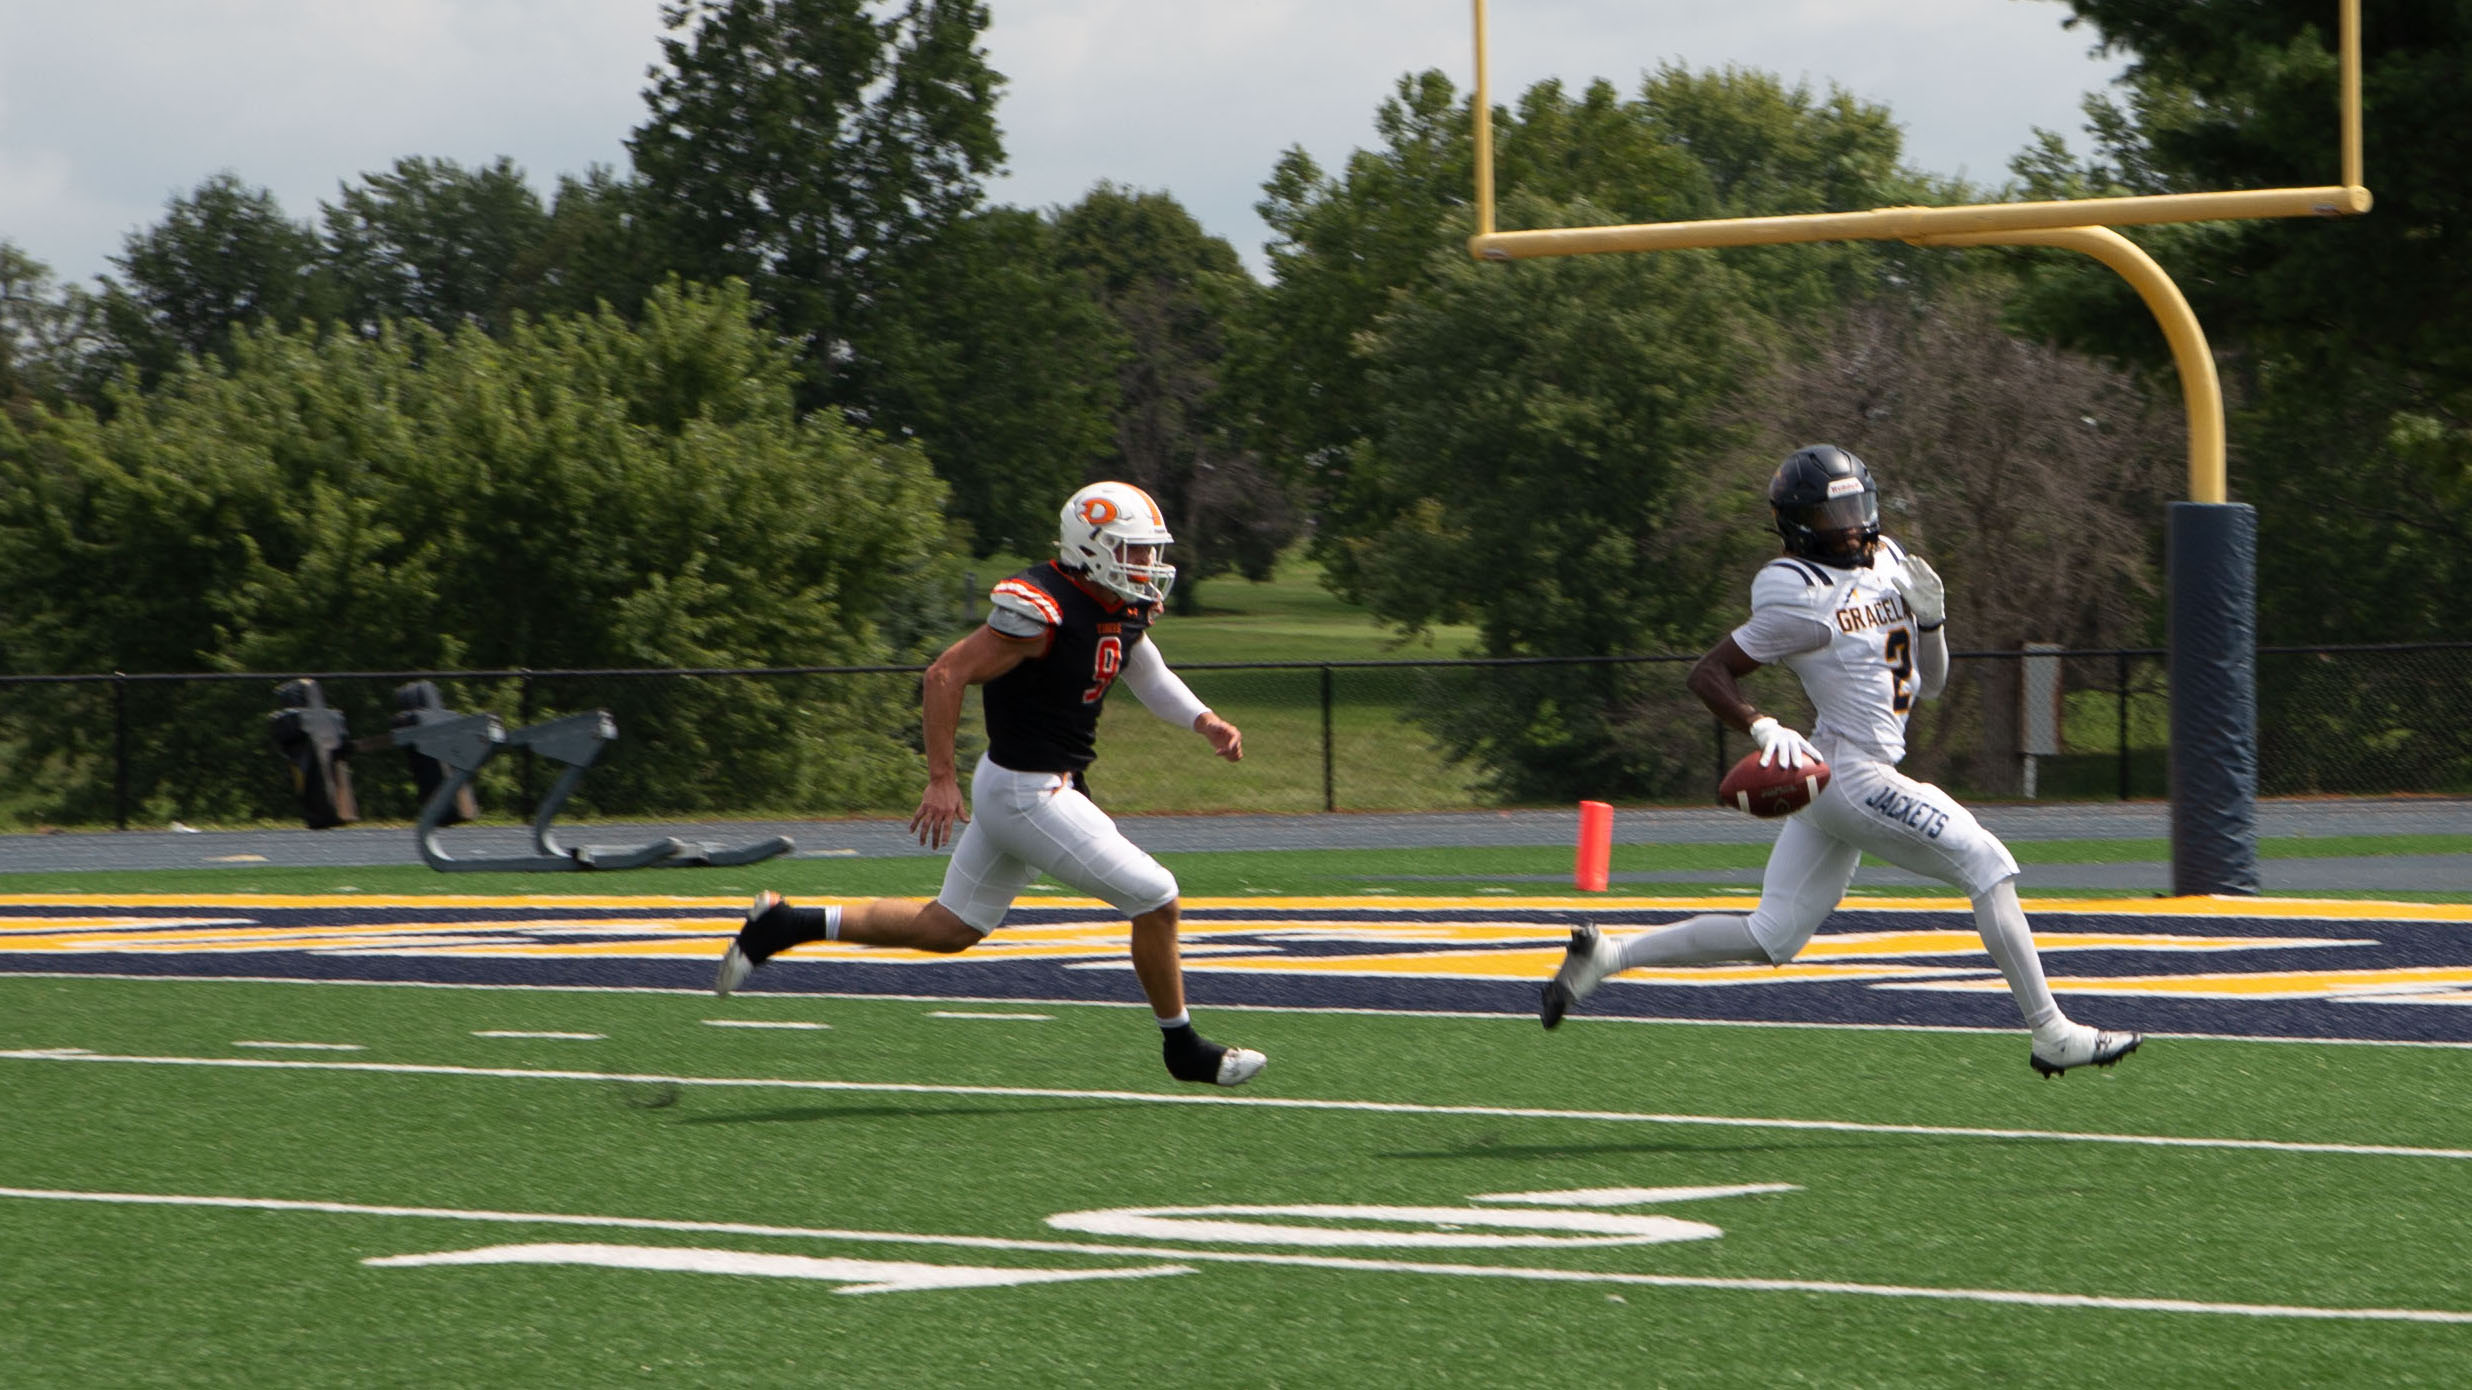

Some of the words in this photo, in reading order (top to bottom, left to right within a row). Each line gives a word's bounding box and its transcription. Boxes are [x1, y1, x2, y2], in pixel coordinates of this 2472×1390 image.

[1082, 635, 1123, 704] 9
[1885, 625, 1913, 715] 2
[1864, 785, 1950, 840] JACKETS
